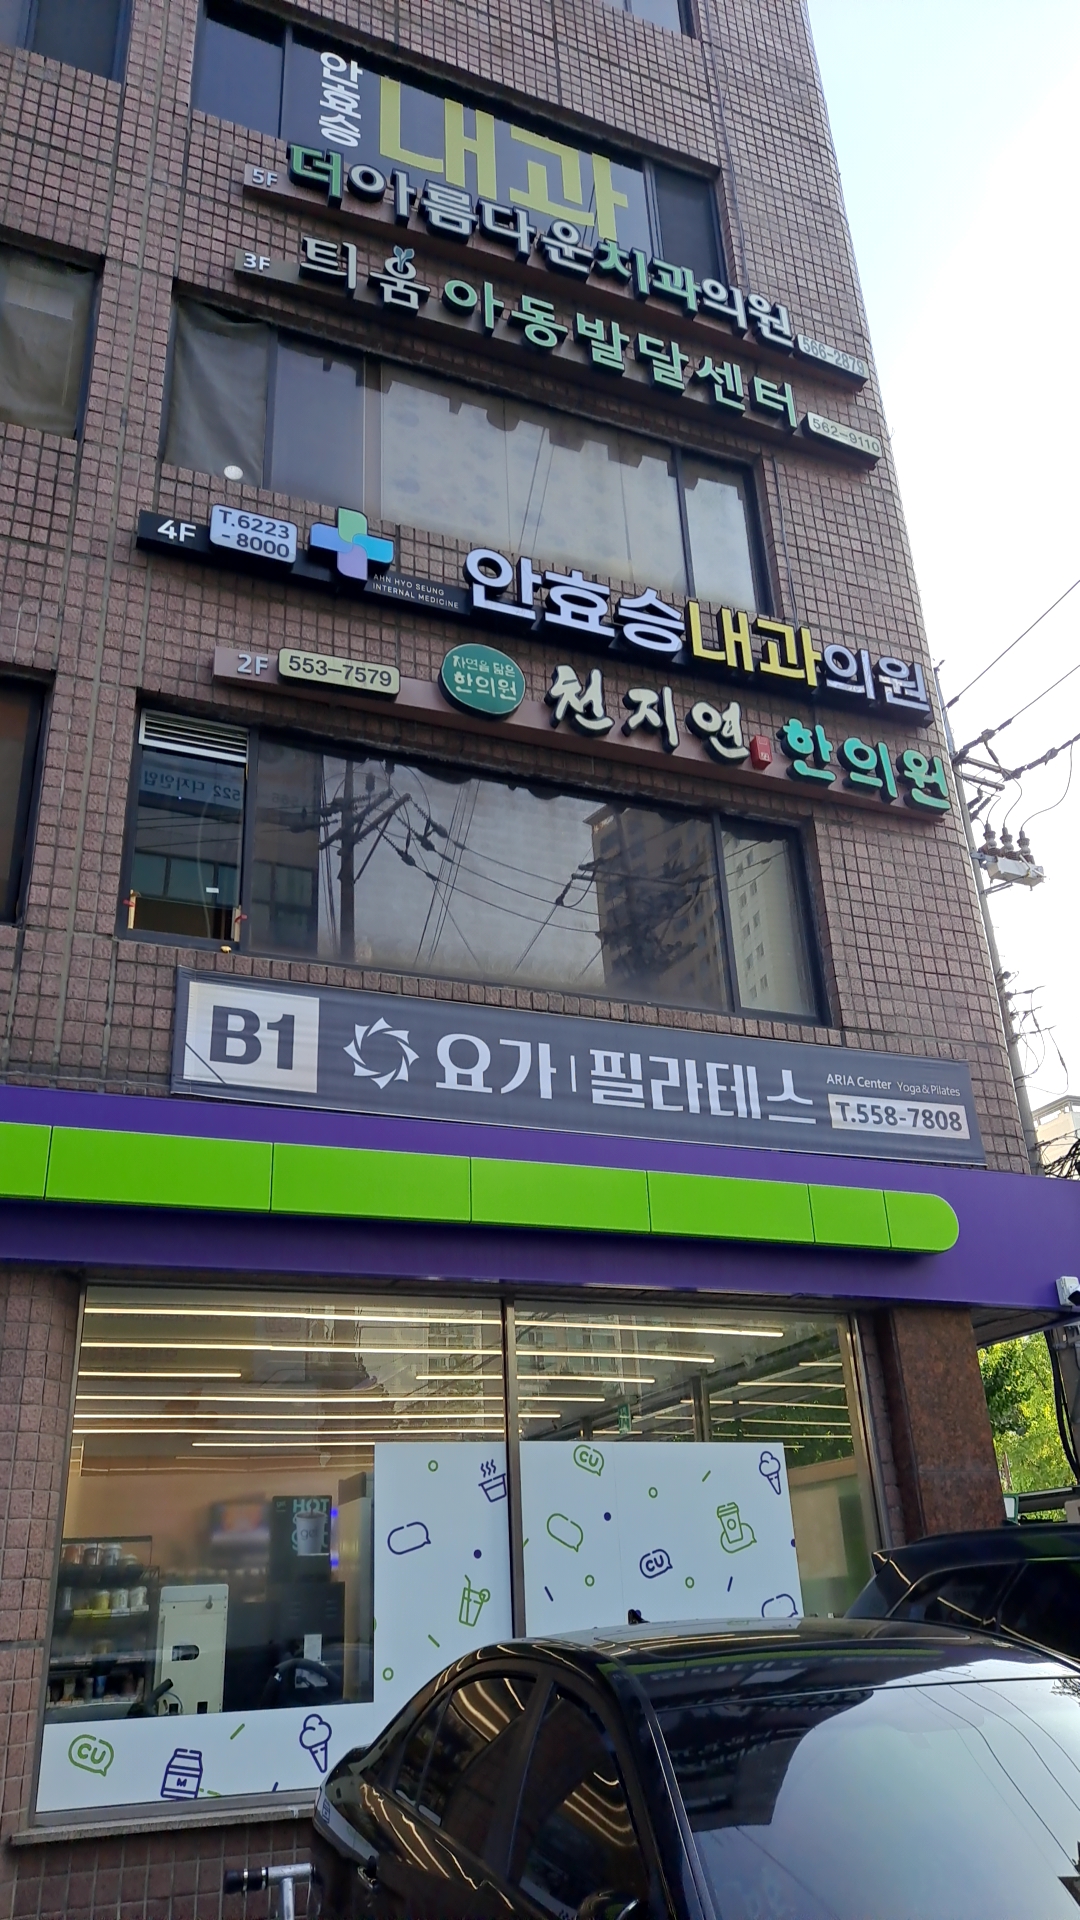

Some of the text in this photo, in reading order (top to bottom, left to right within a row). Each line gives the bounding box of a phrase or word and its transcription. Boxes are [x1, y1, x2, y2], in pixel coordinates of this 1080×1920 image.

[319, 51, 363, 148] 안효승
[380, 75, 629, 241] 내과
[252, 168, 278, 187] 5F
[243, 253, 271, 271] 3F
[803, 336, 865, 375] 566-2879
[813, 417, 880, 453] 562-9110
[157, 519, 197, 543] 4F
[218, 509, 290, 539] T.6223
[372, 582, 459, 609] INTERNAL MEDICINE
[373, 573, 445, 596] AHN HYO SEUNG
[237, 654, 269, 676] 2F
[288, 655, 392, 687] 553-7579
[452, 655, 516, 678] 자연을 닮은
[453, 671, 517, 702] 한의원
[779, 718, 952, 812] 한의원
[210, 1005, 295, 1070] B1
[436, 1033, 817, 1125] 요가 필라테스
[826, 1073, 855, 1087] ARIA
[856, 1077, 892, 1091] Center
[835, 1101, 963, 1132] T.558-7808
[579, 1451, 599, 1467] CU
[292, 1498, 329, 1513] HOT
[645, 1554, 665, 1572] CU
[77, 1743, 106, 1764] CU
